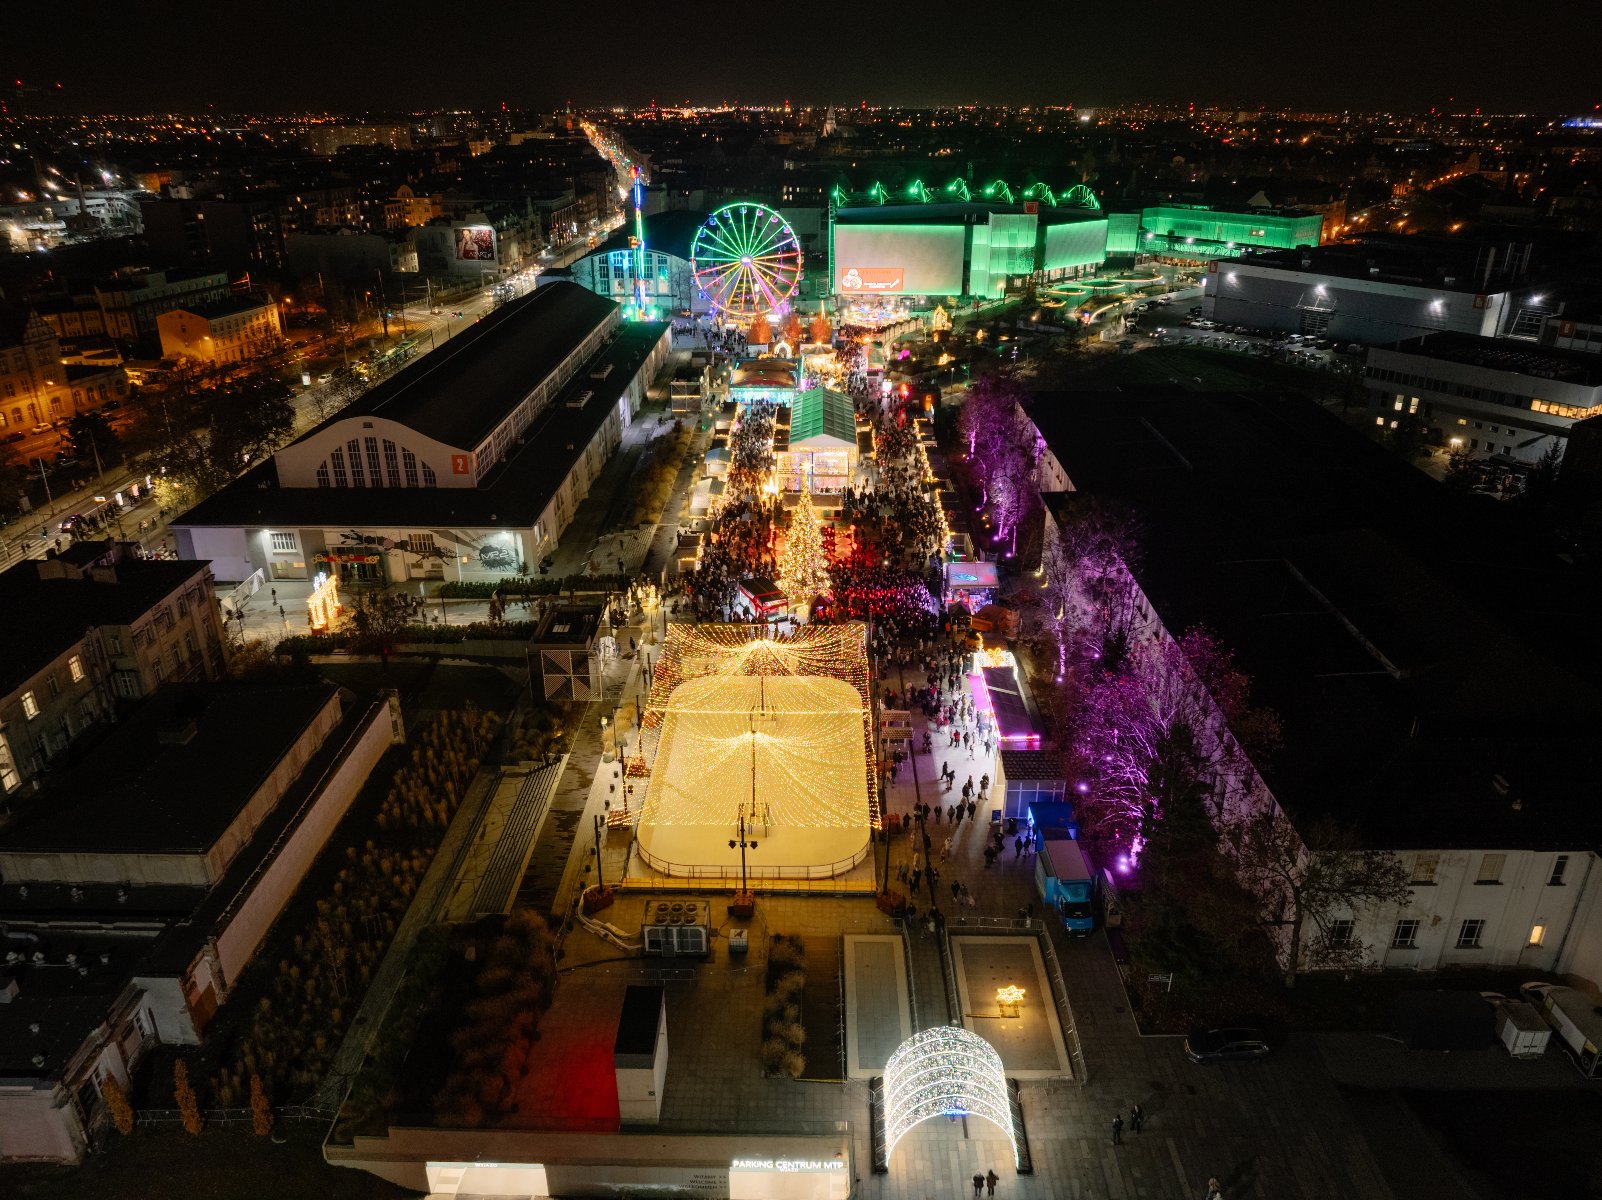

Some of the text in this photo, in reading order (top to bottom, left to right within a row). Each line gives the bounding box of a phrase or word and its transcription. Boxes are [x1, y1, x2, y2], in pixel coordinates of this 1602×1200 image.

[457, 458, 464, 471] 2
[733, 1160, 844, 1169] PARKING CENTRUM MTP
